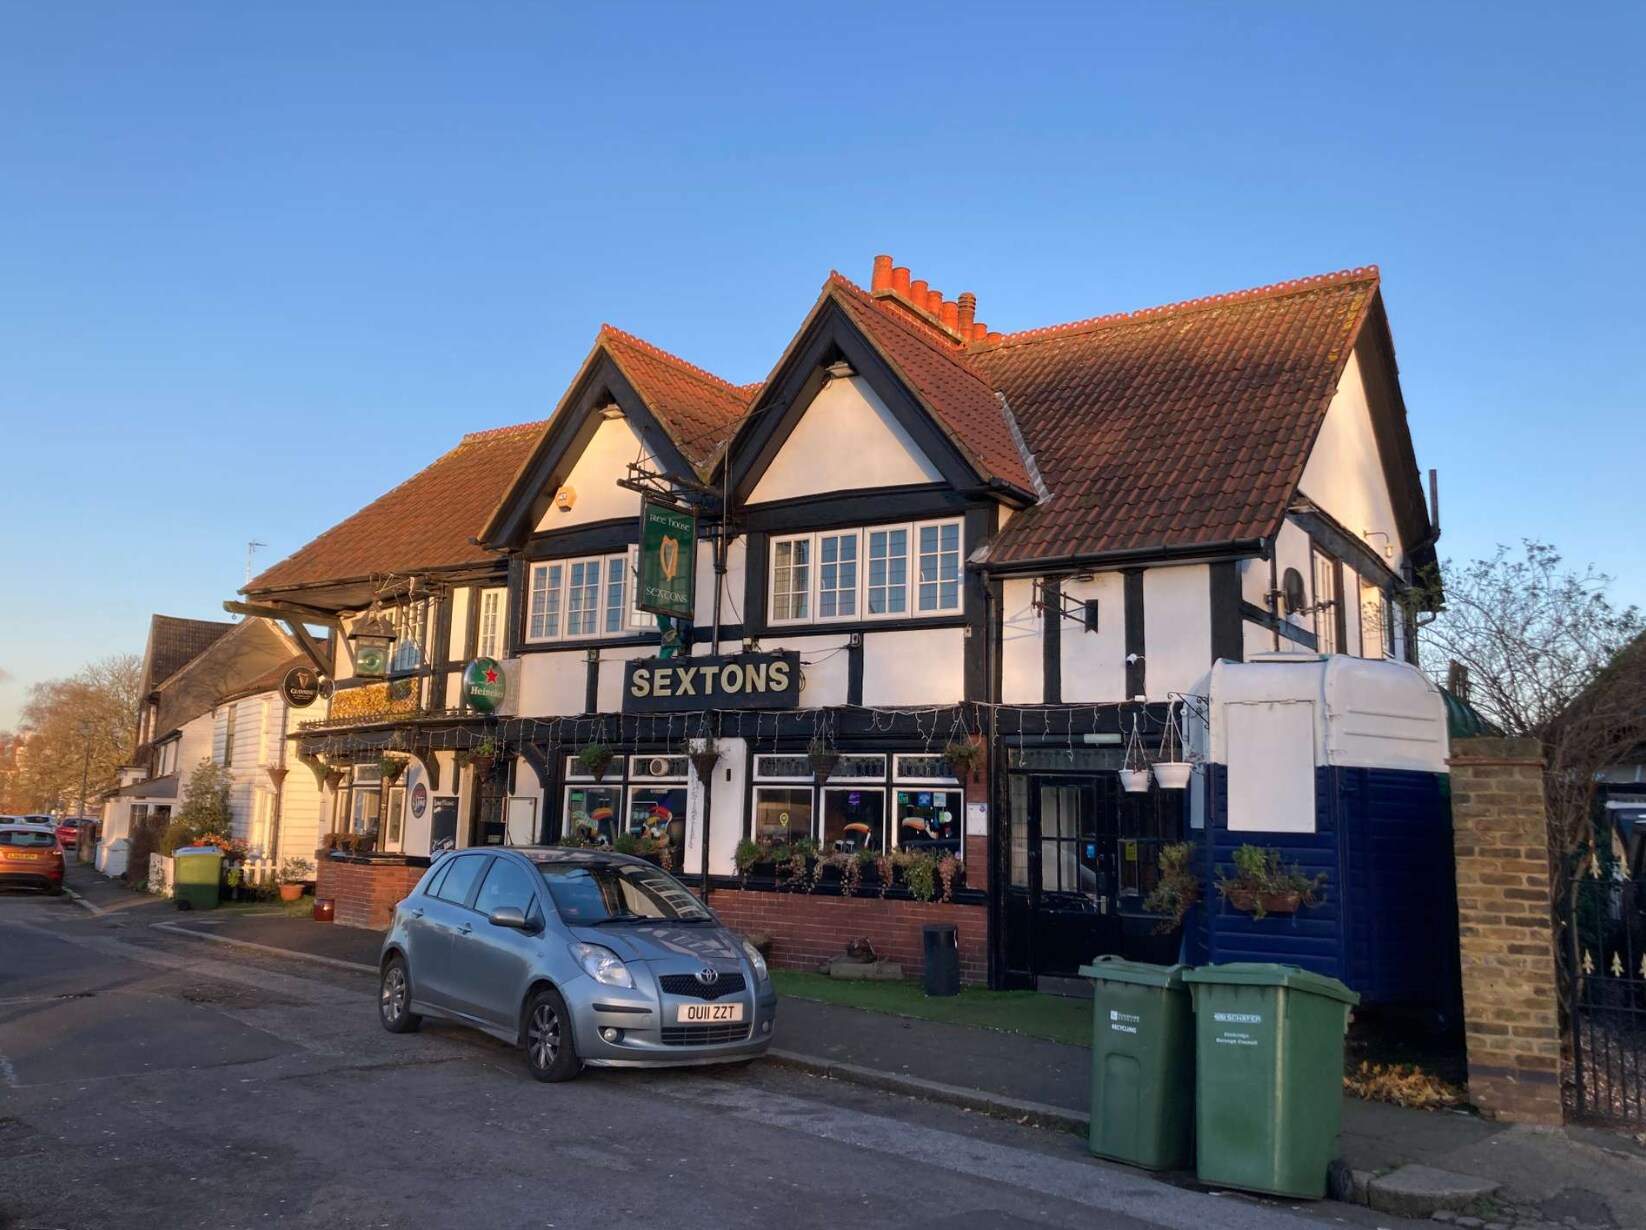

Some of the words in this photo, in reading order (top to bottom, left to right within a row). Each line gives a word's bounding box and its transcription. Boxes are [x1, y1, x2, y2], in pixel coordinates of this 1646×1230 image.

[646, 586, 688, 603] SEXTONS
[630, 661, 790, 698] SEXTONS
[713, 1006, 735, 1019] ZZT
